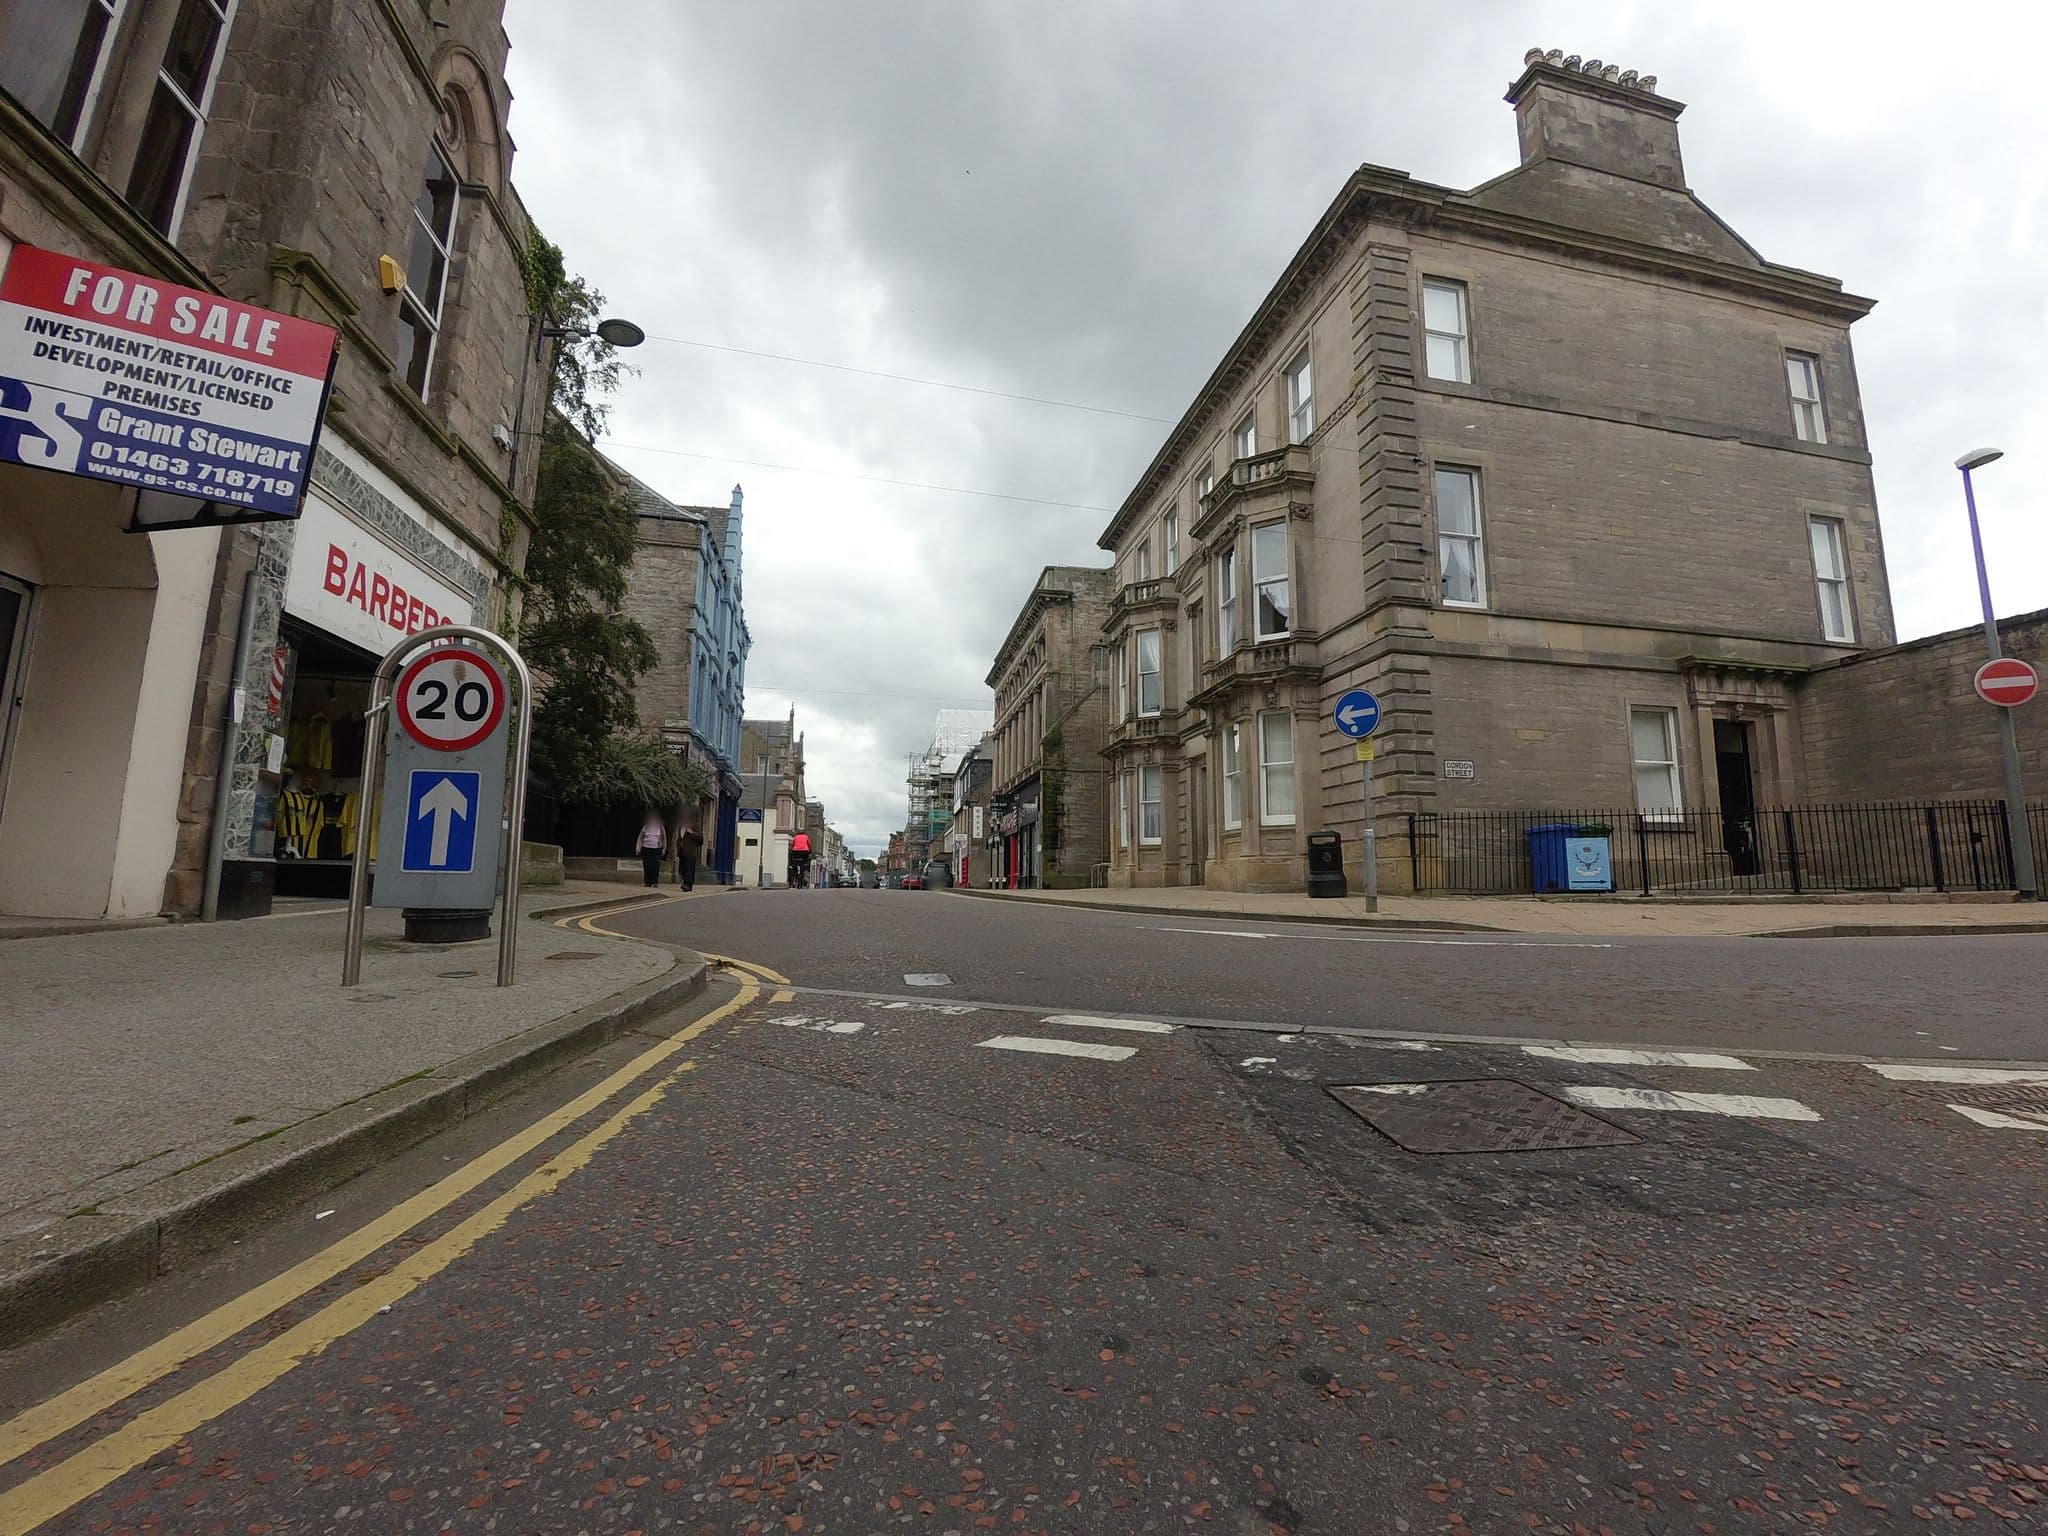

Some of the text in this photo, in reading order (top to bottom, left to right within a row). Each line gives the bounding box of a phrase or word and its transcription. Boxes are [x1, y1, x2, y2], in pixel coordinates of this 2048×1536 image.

[63, 267, 281, 356] FOR SALE
[24, 316, 293, 395] INVESTMENT/RETAIL/OFFICE
[33, 342, 274, 412] DEVELOPMENT/LICENSED
[102, 381, 202, 417] PREMISES
[90, 441, 295, 497] 01463 718719
[97, 407, 302, 473] Grant Stewart
[88, 462, 255, 504] www.gs-cs.co.uk
[415, 680, 489, 722] 20
